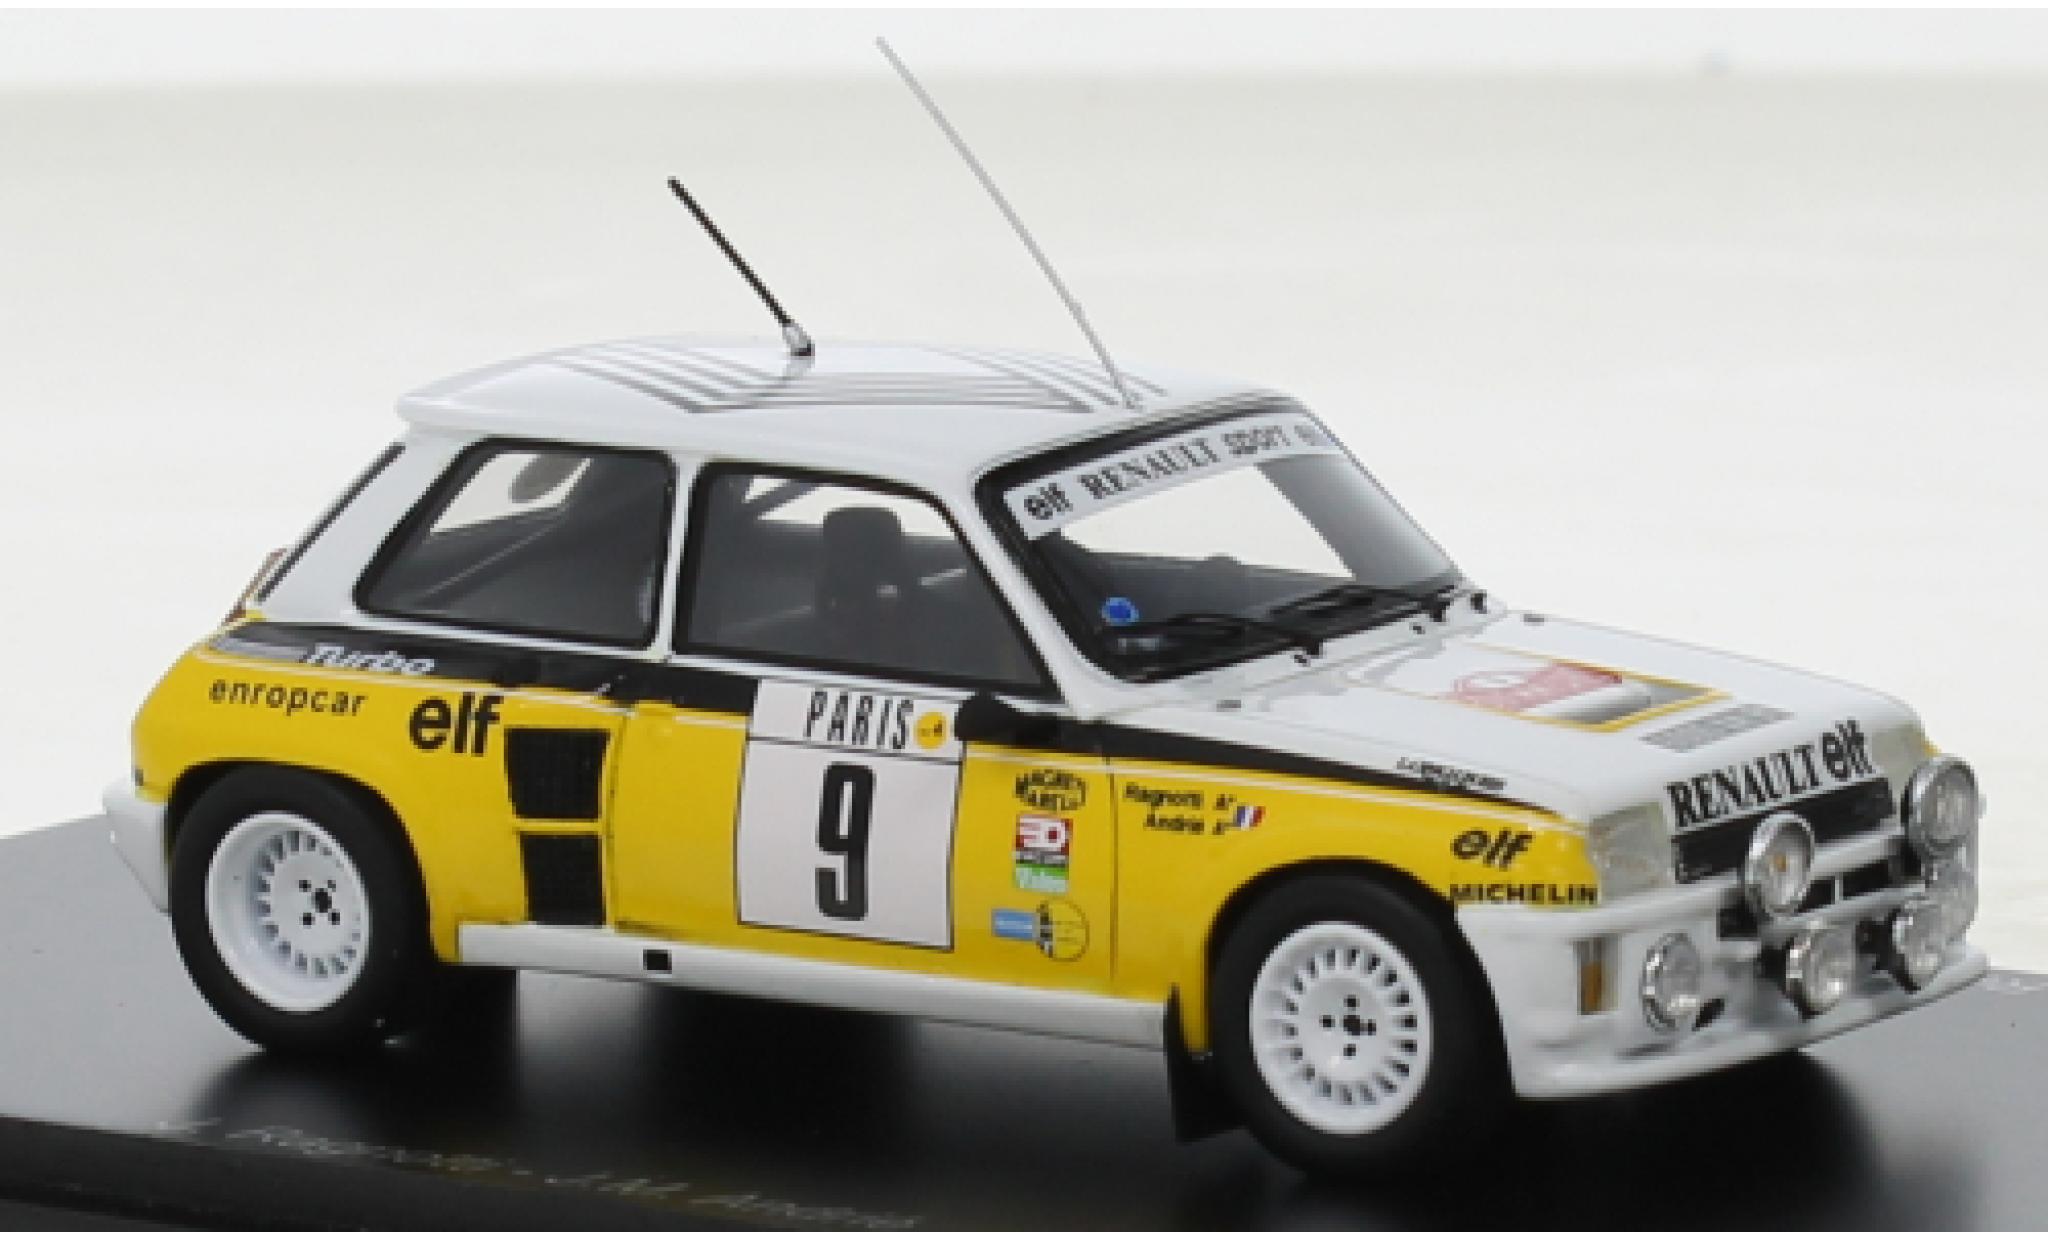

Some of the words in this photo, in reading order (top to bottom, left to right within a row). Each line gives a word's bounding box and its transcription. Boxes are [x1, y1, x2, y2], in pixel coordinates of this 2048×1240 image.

[1023, 482, 1074, 520] elf
[1076, 437, 1221, 500] RENAULT
[408, 691, 504, 757] elf
[803, 690, 914, 750] PARIS
[1665, 743, 1824, 828] RENAULT
[1821, 718, 1874, 783] elf
[814, 760, 876, 921] 9
[1449, 827, 1535, 871] elf
[1448, 882, 1599, 903] MICHELIN
